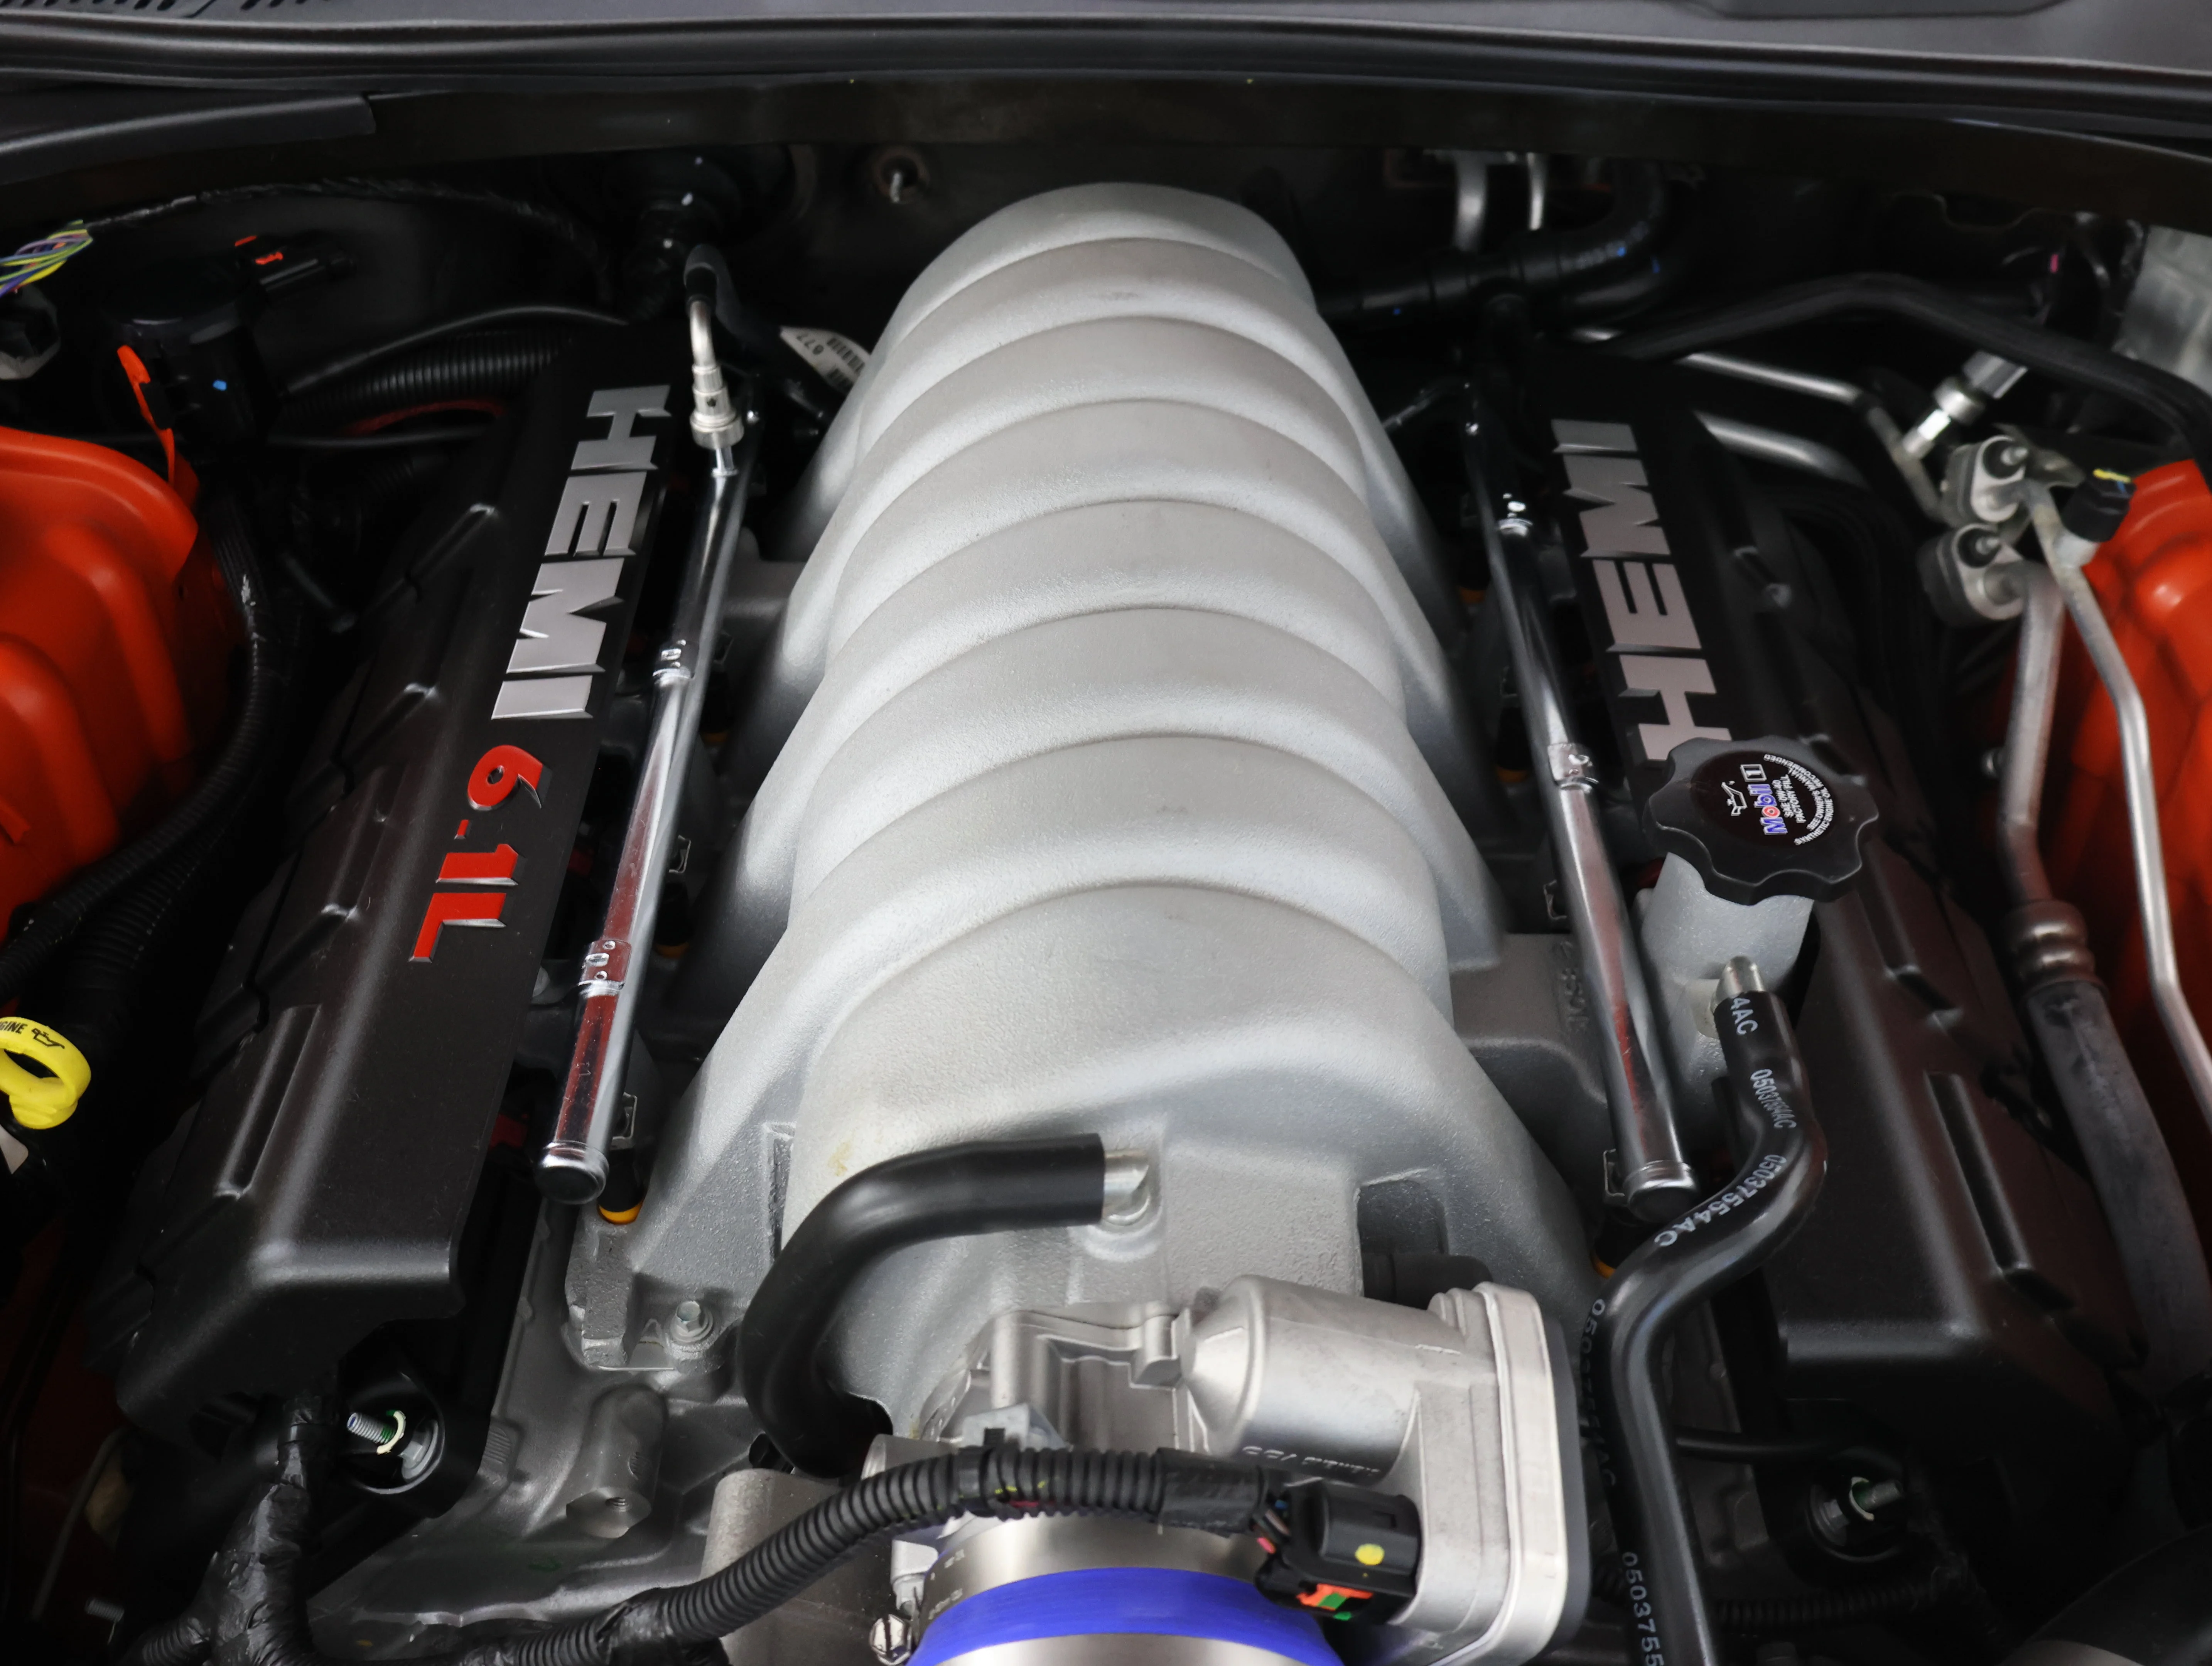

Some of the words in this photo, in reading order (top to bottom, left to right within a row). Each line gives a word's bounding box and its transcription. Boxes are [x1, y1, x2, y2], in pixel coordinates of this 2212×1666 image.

[491, 384, 672, 720] HEMI
[1551, 419, 1733, 761] HEMI
[1763, 754, 1824, 788] RECOMMENDED
[1780, 774, 1793, 790] FILL
[1788, 767, 1817, 791] MANUAL
[1747, 784, 1788, 835] Mobil
[1786, 790, 1806, 823] FACTORY
[1820, 787, 1831, 799] OIL
[1780, 802, 1794, 818] SAE
[1806, 817, 1821, 831] SEE
[1824, 798, 1834, 822] ENGINE
[1794, 820, 1830, 846] SYNTHETIC
[408, 744, 544, 963] 6.1L
[1730, 998, 1758, 1035] 4AC
[1654, 1154, 1787, 1247] 05037554AC
